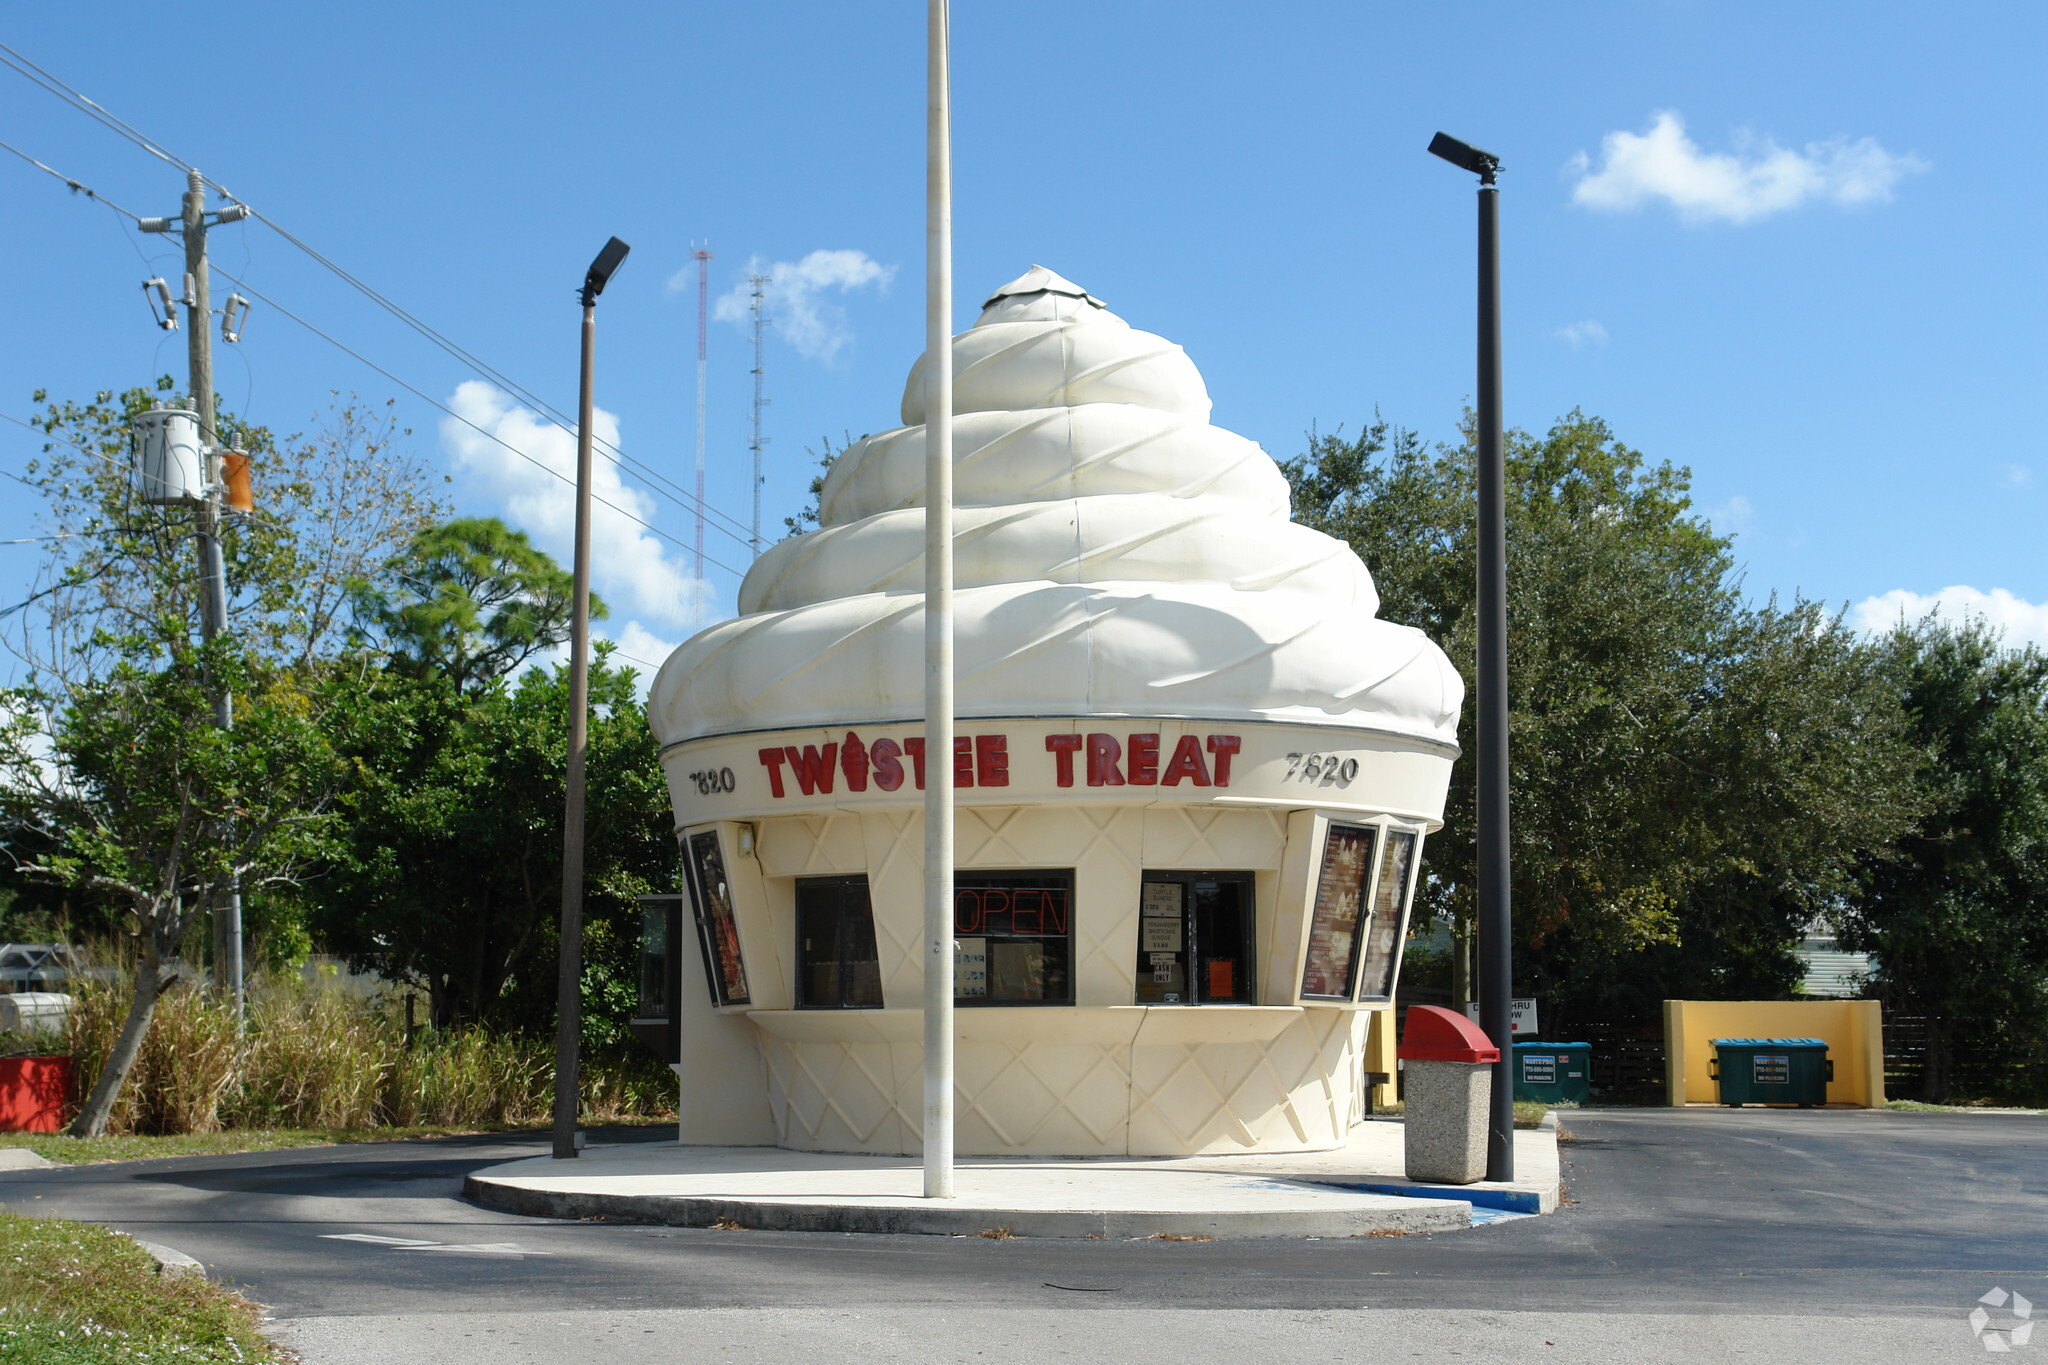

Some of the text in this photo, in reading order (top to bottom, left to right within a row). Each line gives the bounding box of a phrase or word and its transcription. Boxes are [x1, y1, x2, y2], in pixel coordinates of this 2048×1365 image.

[1045, 733, 1242, 788] TREAT
[1286, 752, 1359, 783] 7820
[689, 767, 735, 795] 7820
[954, 890, 1068, 934] OPEN
[1154, 974, 1169, 982] ONLY
[1511, 1002, 1530, 1010] HRU
